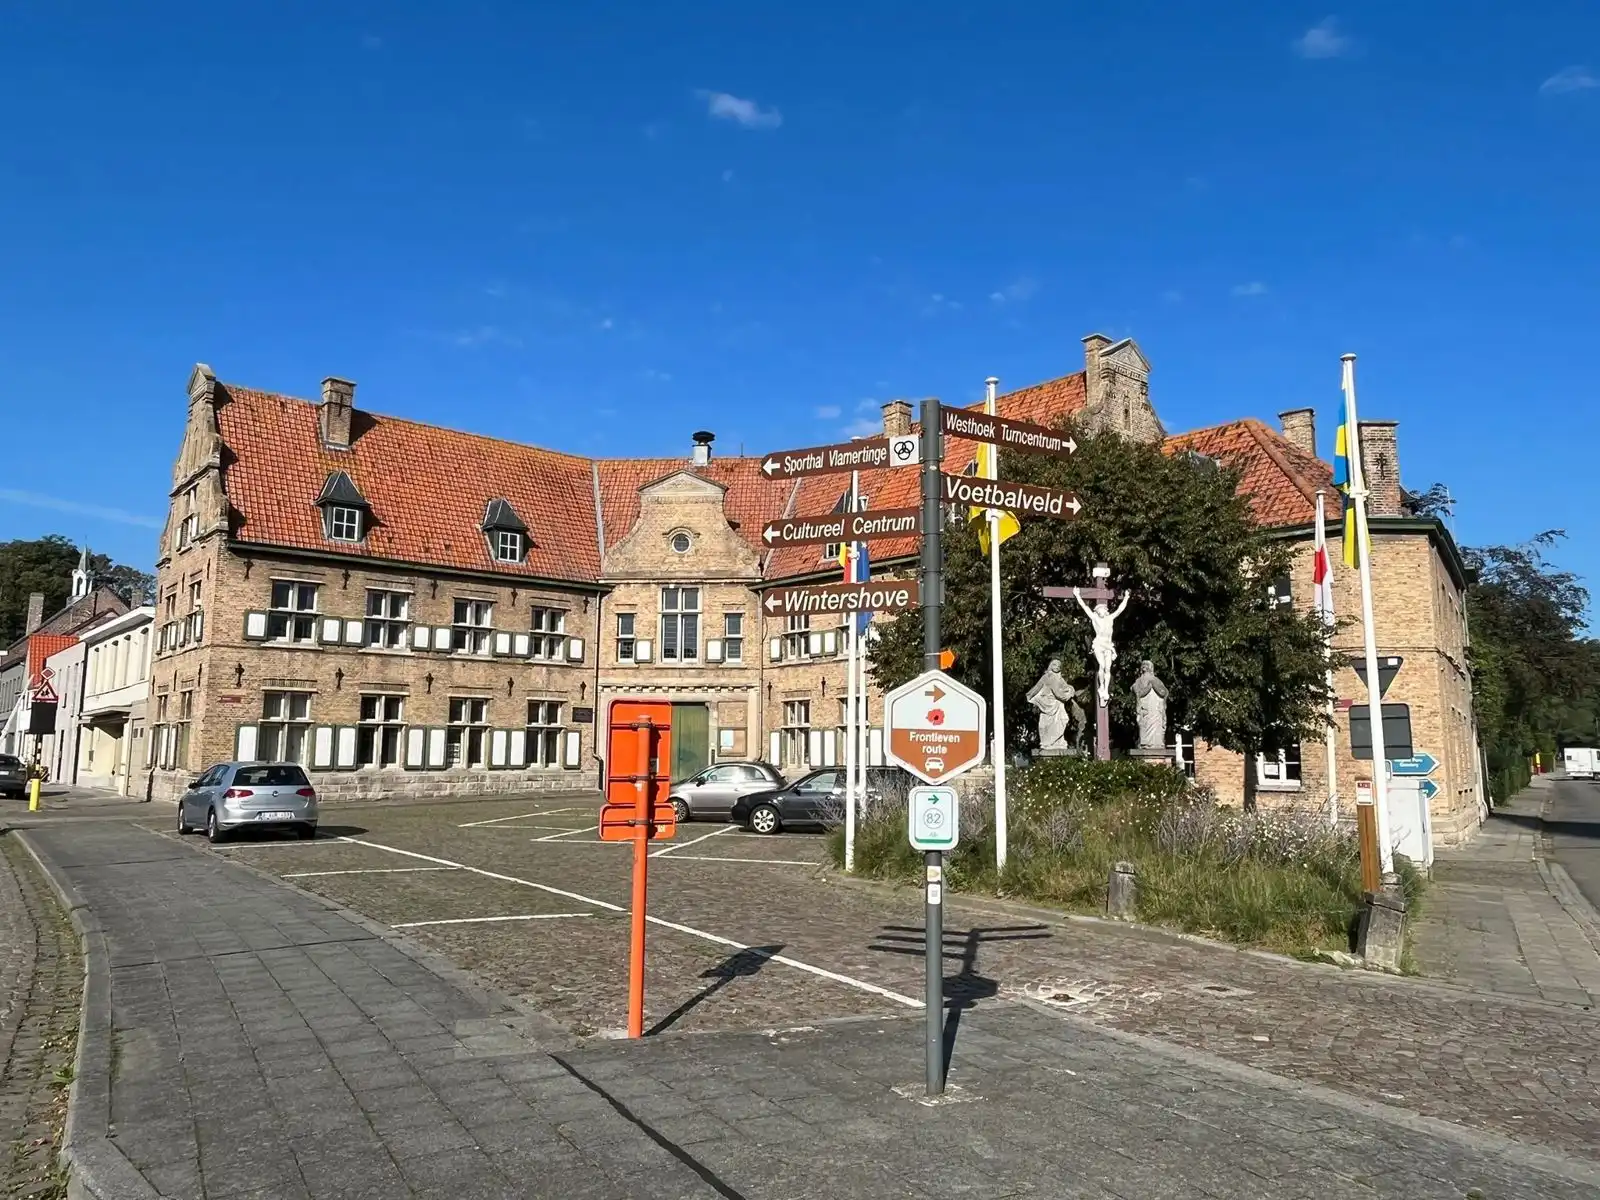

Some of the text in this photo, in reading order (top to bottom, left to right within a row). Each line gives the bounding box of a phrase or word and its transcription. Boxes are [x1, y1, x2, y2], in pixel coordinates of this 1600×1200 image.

[946, 412, 1061, 451] Westhoek Turncentrum
[784, 446, 887, 475] Sporthal Vlamertinge
[946, 477, 1063, 514] Voetbalveld
[782, 514, 915, 541] Cultureel Centrum
[785, 587, 908, 612] Wintershove
[922, 745, 948, 754] route
[926, 813, 941, 824] 82
